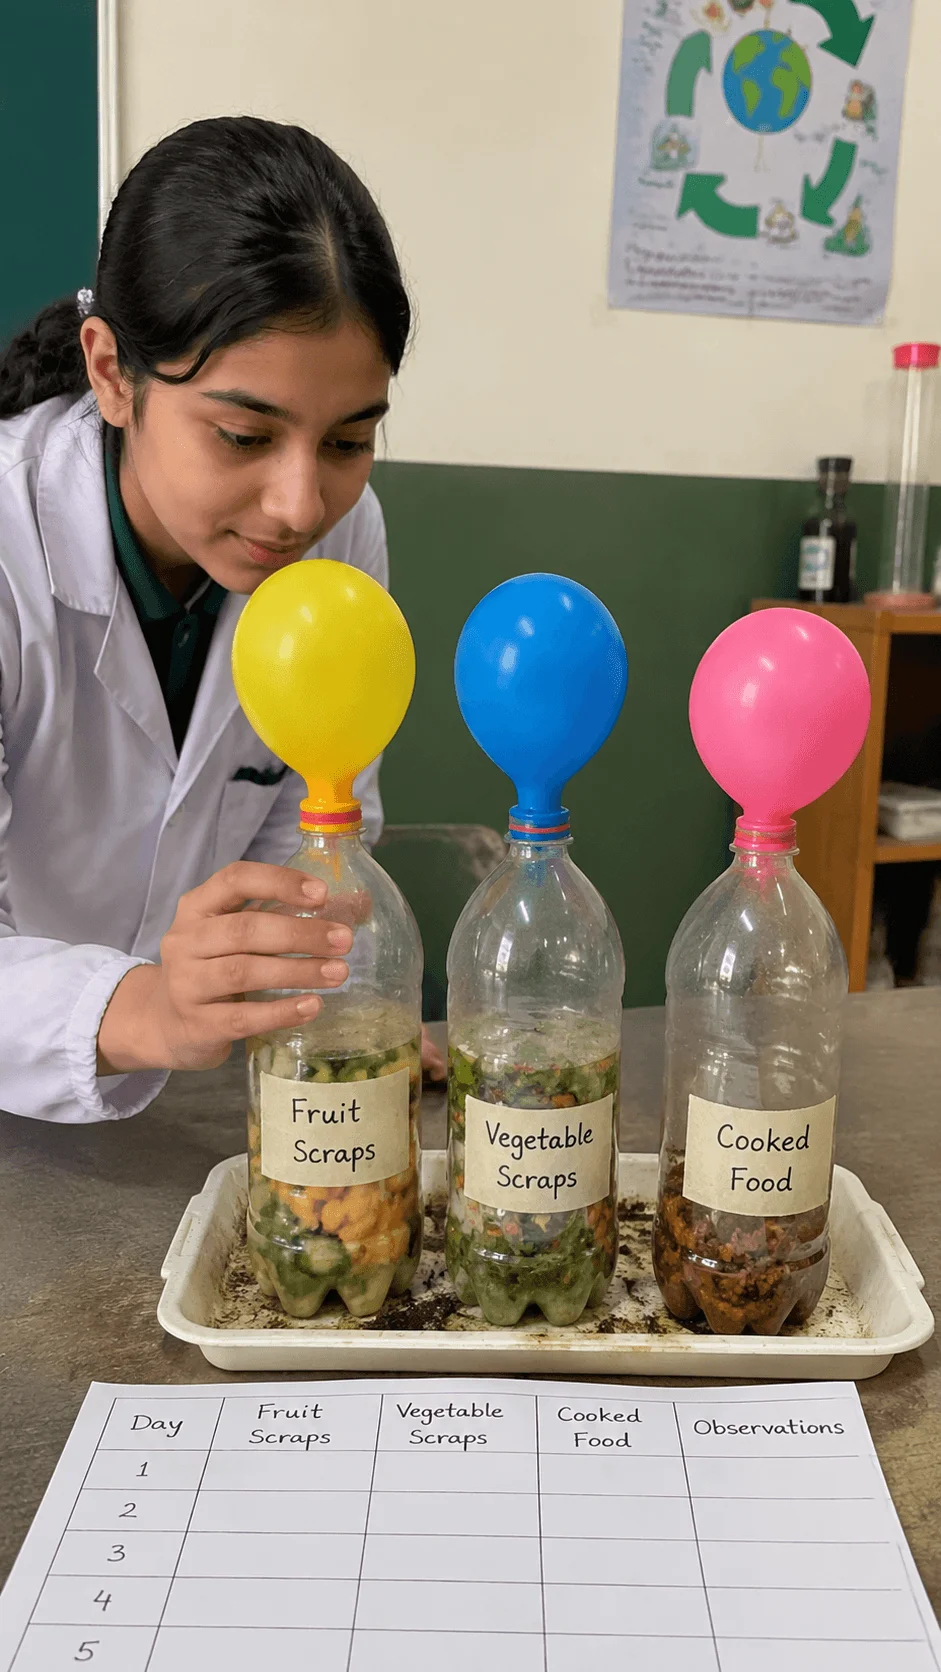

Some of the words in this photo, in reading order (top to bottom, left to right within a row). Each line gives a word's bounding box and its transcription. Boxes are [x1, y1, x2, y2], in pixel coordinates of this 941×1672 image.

[292, 1098, 361, 1124] Fruit
[485, 1120, 595, 1160] Vegetable
[717, 1123, 811, 1152] Cooked
[293, 1139, 376, 1173] Scraps
[497, 1165, 579, 1199] Scraps
[731, 1166, 792, 1192] Food
[258, 1403, 323, 1419] Fruit
[397, 1403, 503, 1425] Vegetable
[558, 1407, 642, 1422] Cooked
[131, 1415, 183, 1438] Day
[694, 1419, 844, 1435] Observations
[249, 1429, 331, 1451] Scraps
[409, 1429, 488, 1451] Scraps
[574, 1432, 632, 1447] Food
[136, 1462, 147, 1476] 1
[119, 1503, 137, 1517] 2
[107, 1545, 125, 1562] 3
[94, 1590, 111, 1611] 4
[74, 1641, 99, 1661] 5
